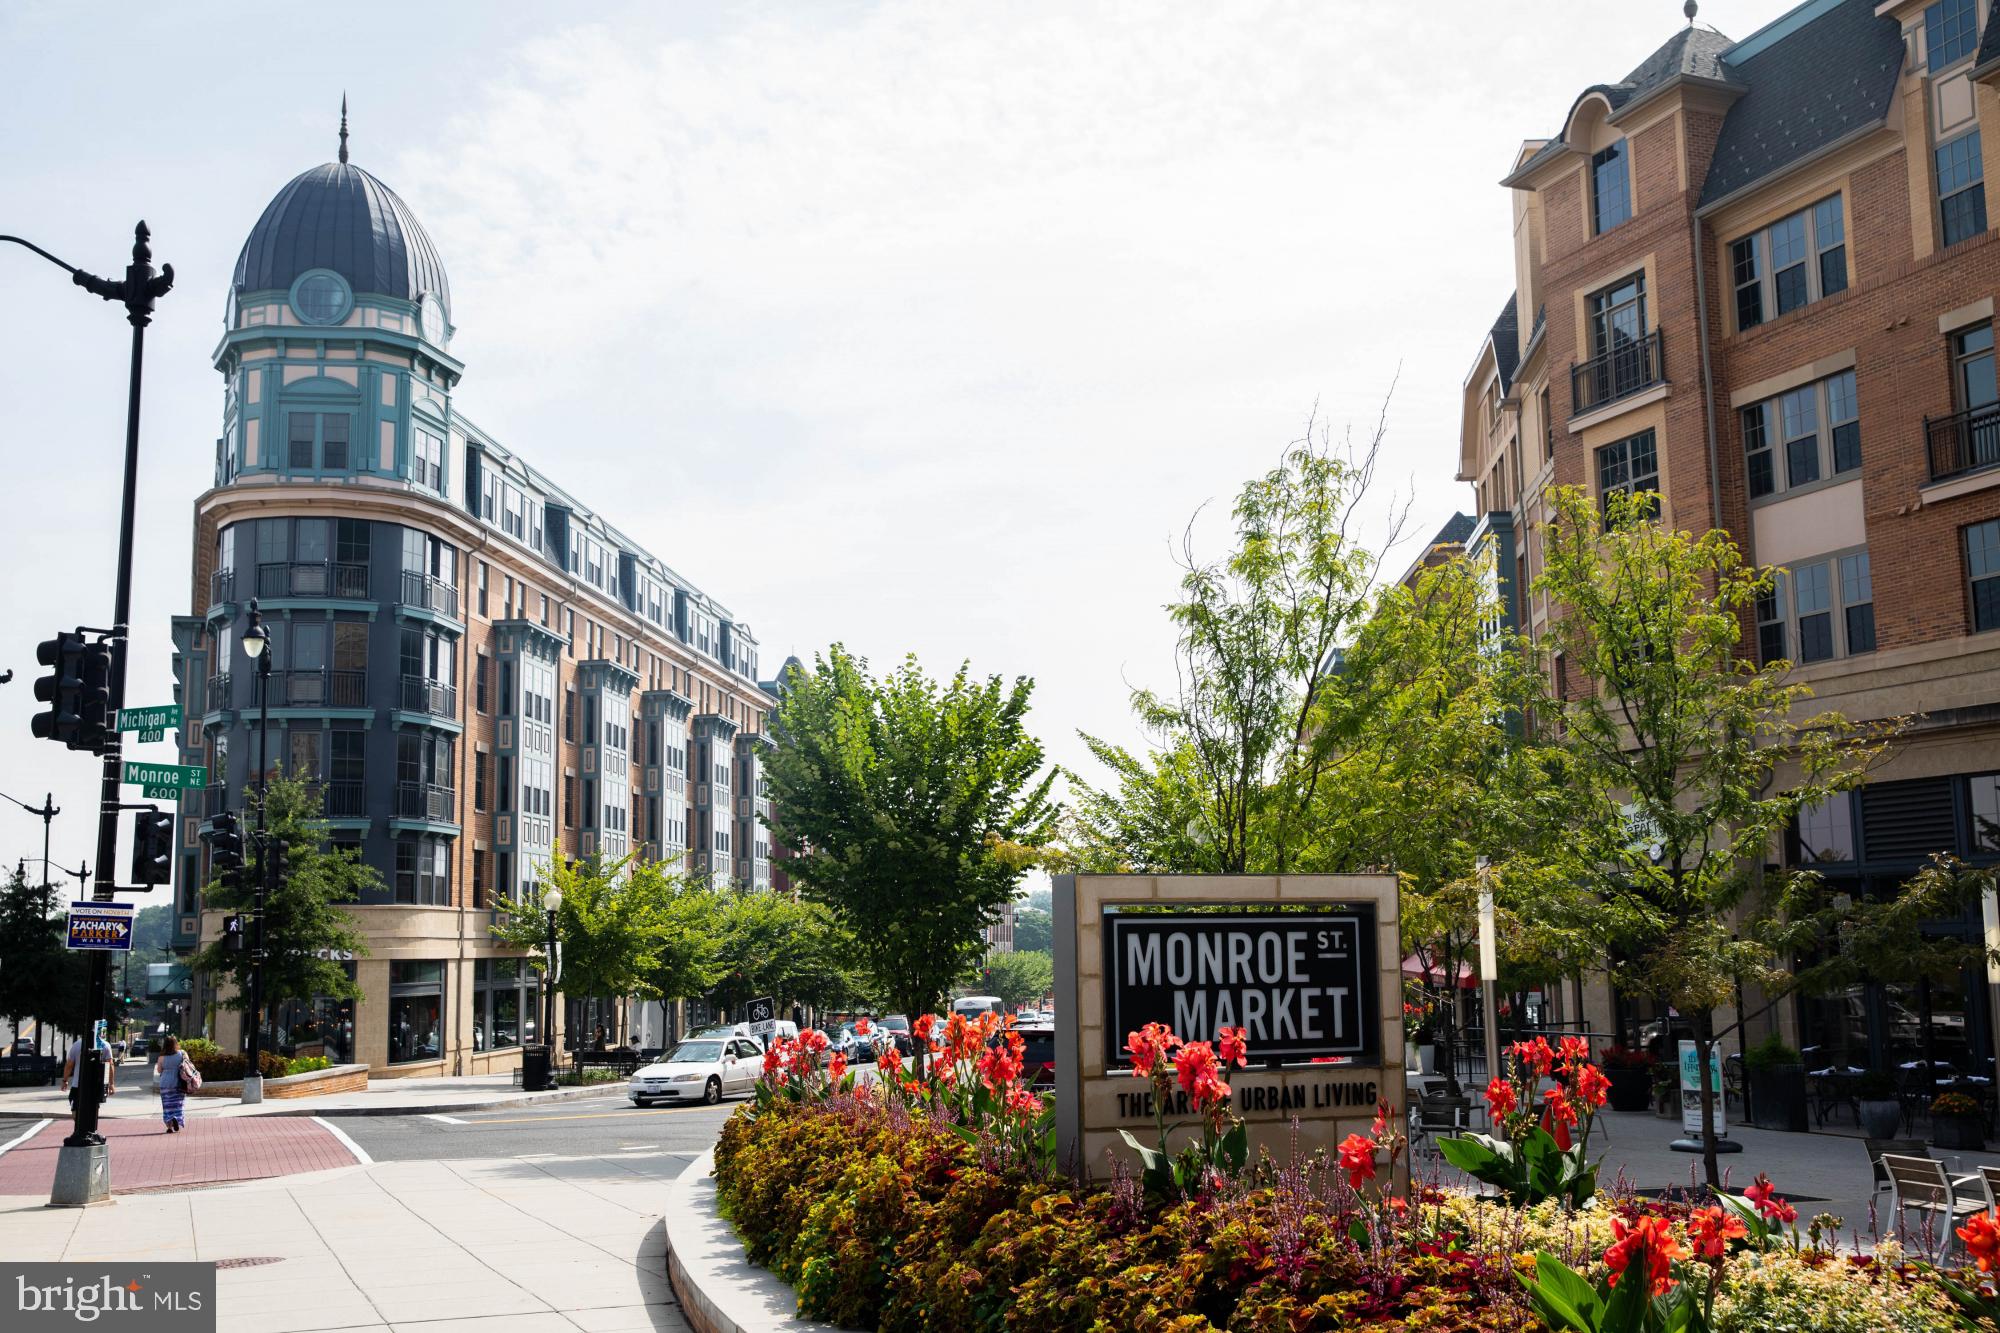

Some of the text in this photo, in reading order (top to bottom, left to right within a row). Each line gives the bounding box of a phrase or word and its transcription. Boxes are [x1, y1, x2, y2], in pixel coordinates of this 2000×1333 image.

[120, 711, 166, 729] Michigan
[140, 731, 161, 742] 400
[128, 765, 179, 784] Monroe
[191, 769, 201, 777] ST
[190, 778, 201, 786] NE
[150, 788, 177, 799] 600
[73, 921, 117, 930] ZACHARY
[72, 928, 118, 938] PARKER
[1127, 930, 1347, 986] MONROE ST.
[1174, 987, 1348, 1042] MARKET
[751, 1020, 774, 1033] BIKE LANE
[1117, 1092, 1154, 1118] THE
[1163, 1090, 1198, 1115] AR
[1241, 1085, 1306, 1111] URBAN
[1314, 1082, 1377, 1108] LIVING
